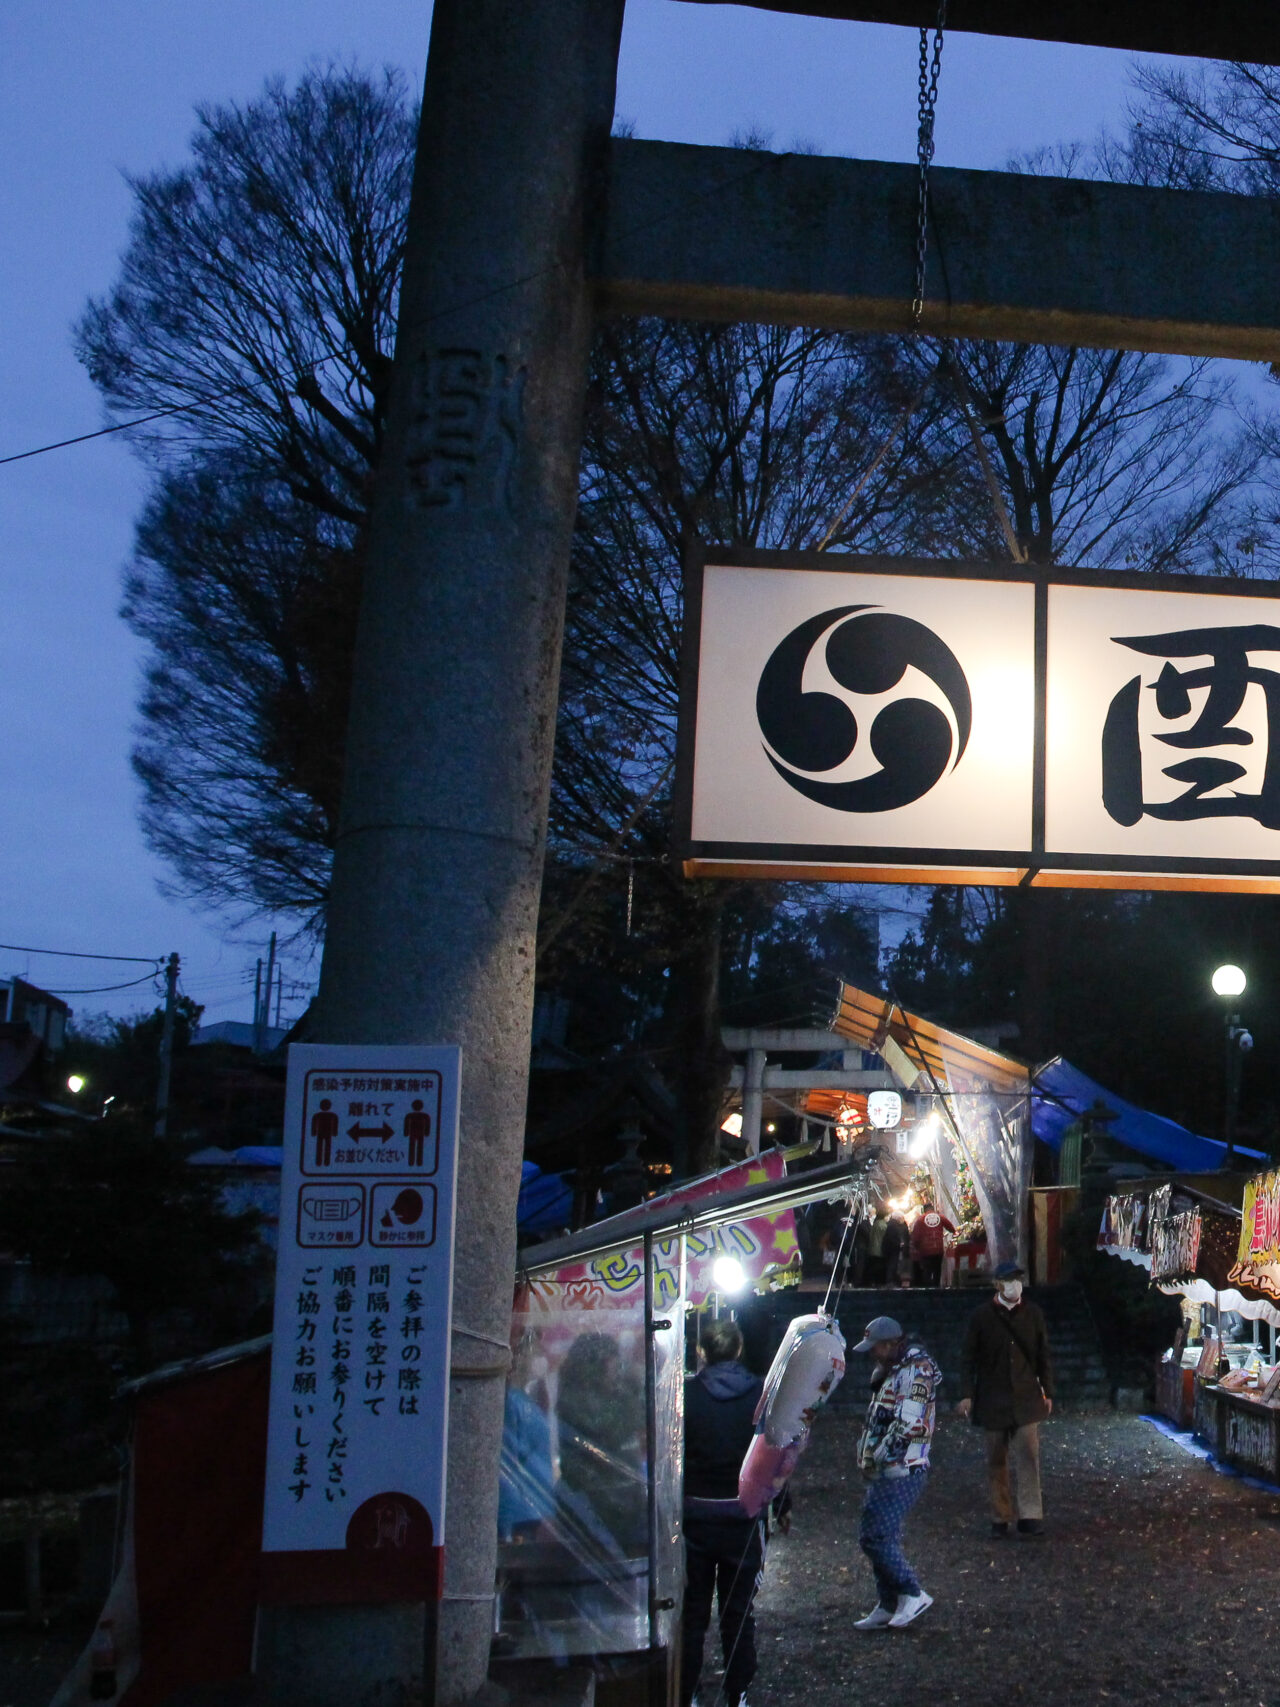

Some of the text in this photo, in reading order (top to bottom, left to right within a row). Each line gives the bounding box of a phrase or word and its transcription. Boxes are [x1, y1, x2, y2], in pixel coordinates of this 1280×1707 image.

[311, 1077, 435, 1093] 感染予防対策実施中
[347, 1102, 396, 1118] 離れて
[334, 1148, 405, 1164] お並びください
[306, 1230, 355, 1243] マスク着用
[363, 1263, 391, 1417] 間隔を空けて
[397, 1264, 428, 1416] ご参拝の際は
[287, 1265, 323, 1504] ご協力お願いします
[325, 1264, 357, 1503] 順番にお参りください
